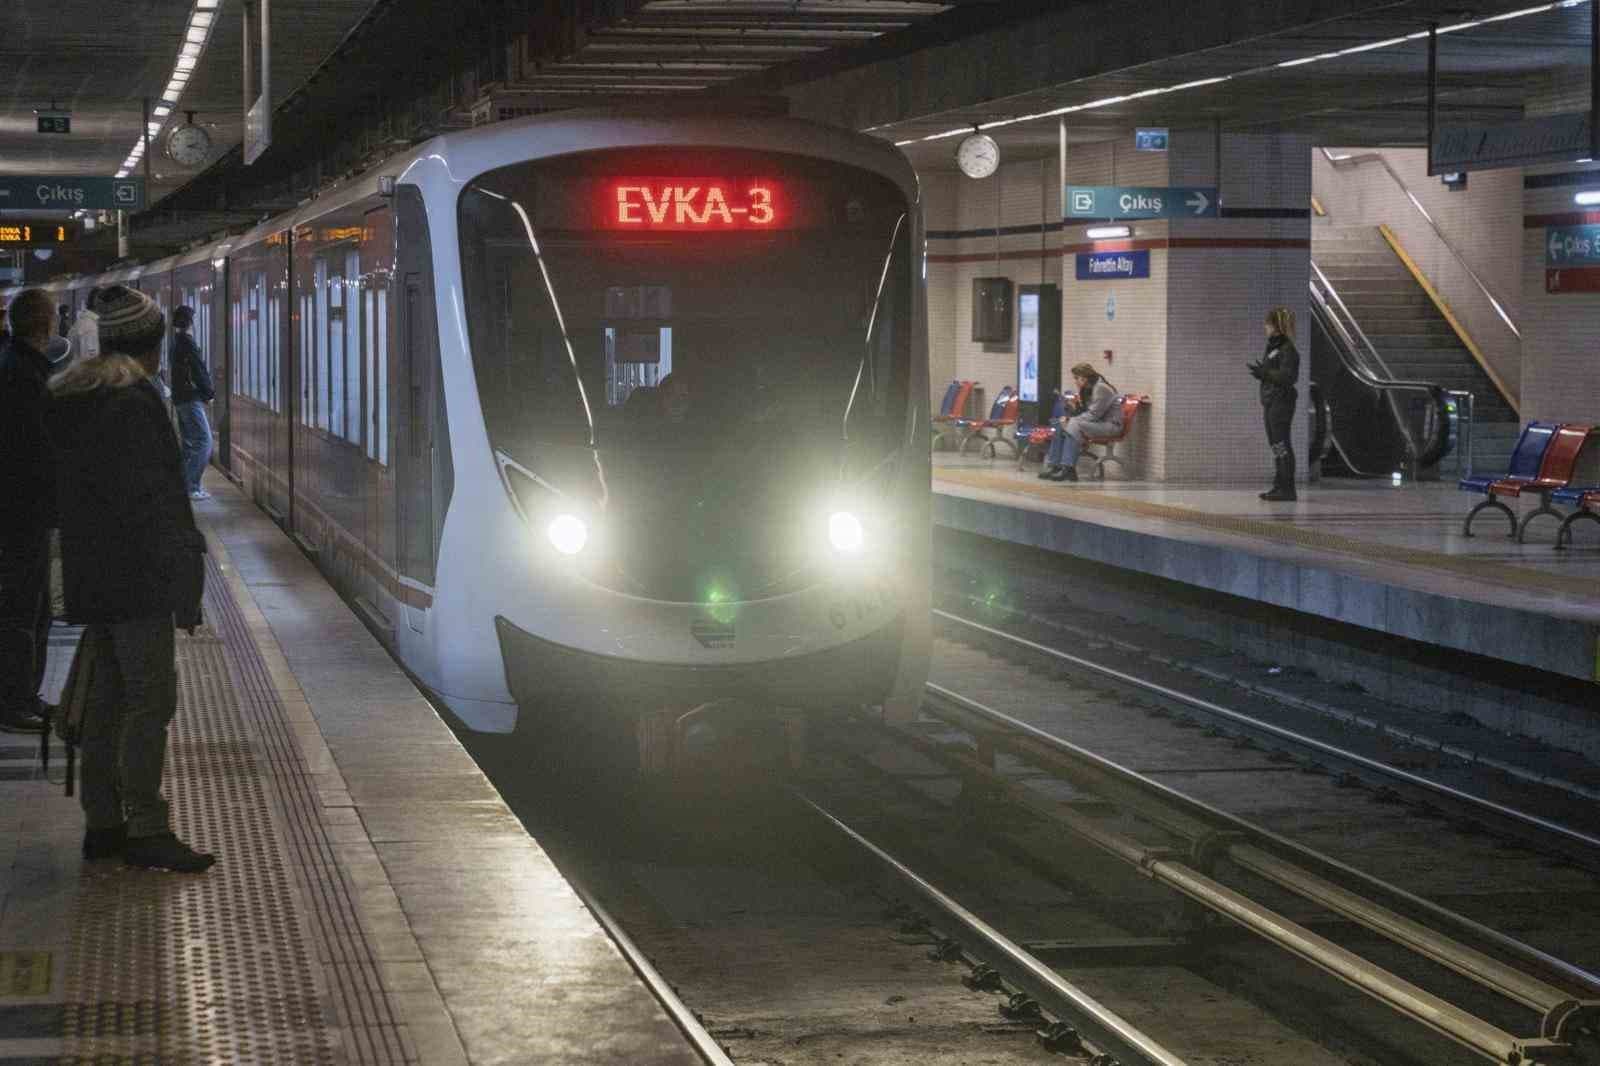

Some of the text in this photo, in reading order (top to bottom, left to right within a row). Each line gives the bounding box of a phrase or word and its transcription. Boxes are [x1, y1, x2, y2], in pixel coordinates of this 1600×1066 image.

[36, 184, 84, 205] Çıkış
[1119, 194, 1162, 213] Çıkış
[616, 186, 775, 224] EVKA-3
[1117, 256, 1134, 275] Altay
